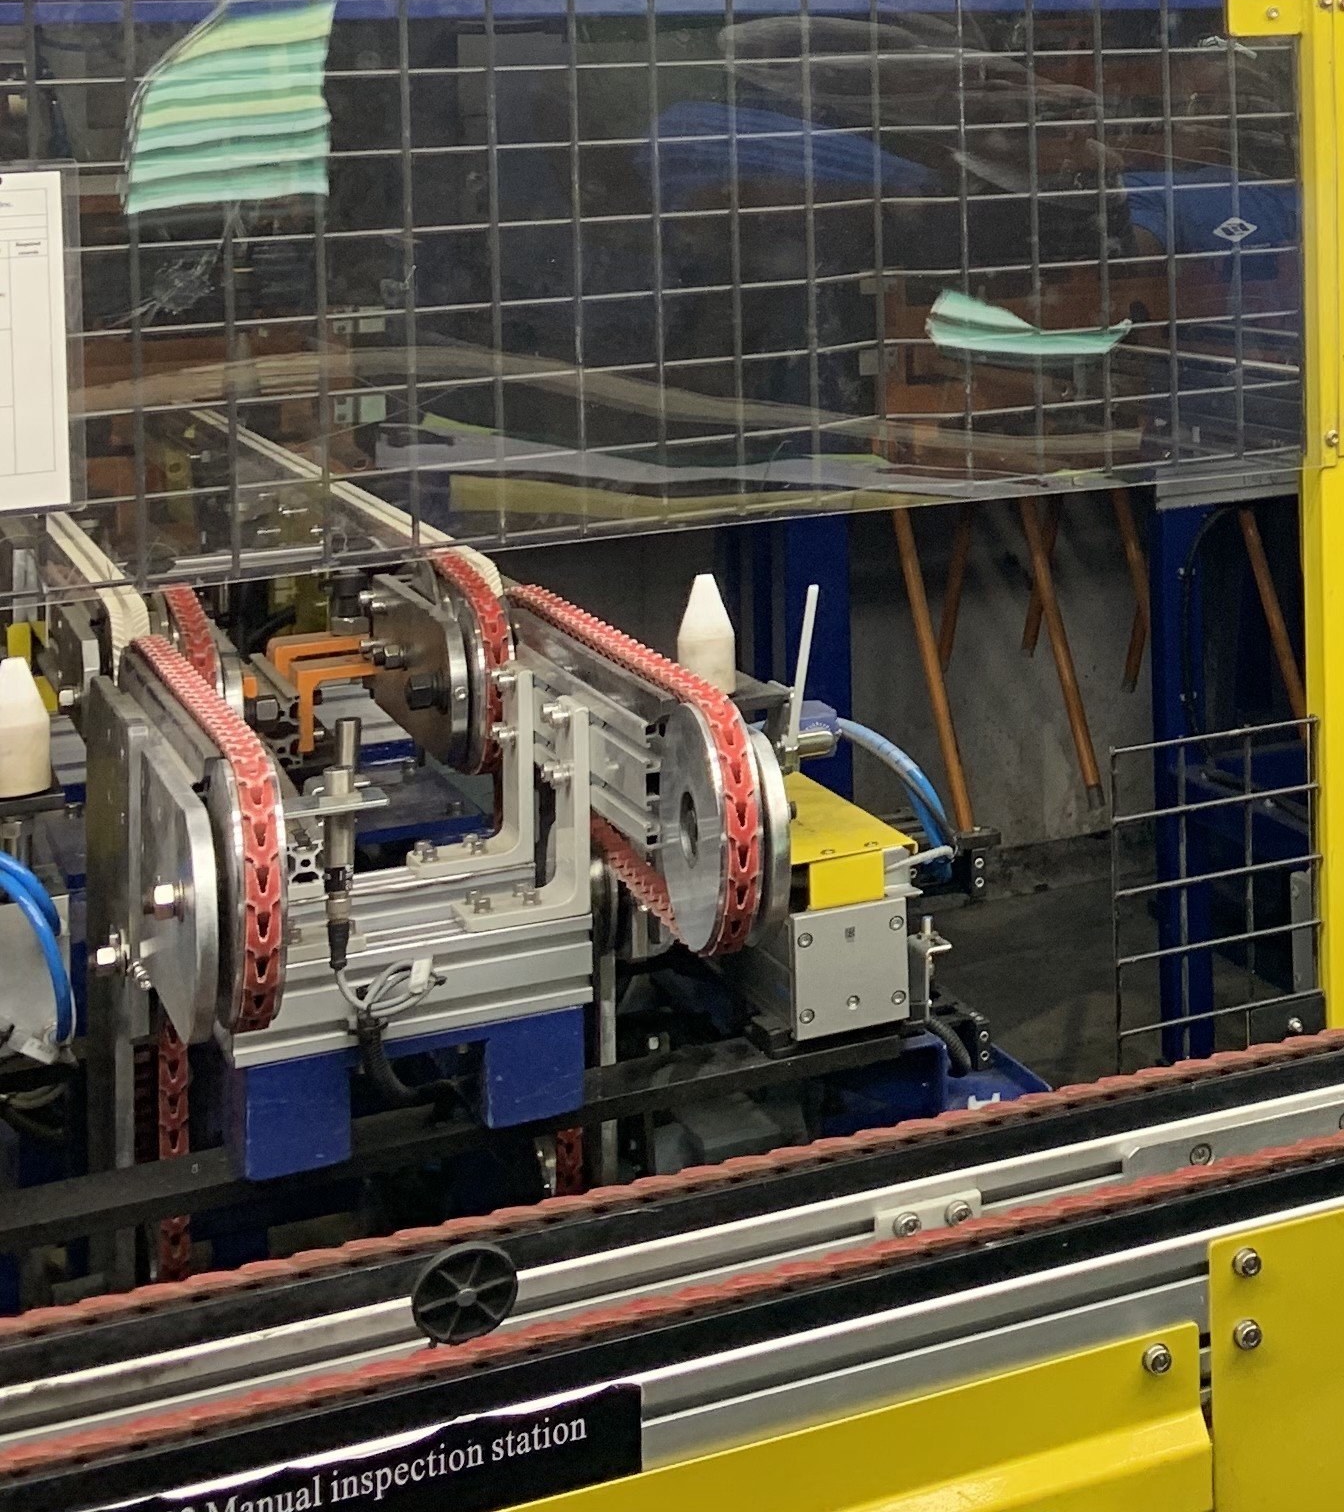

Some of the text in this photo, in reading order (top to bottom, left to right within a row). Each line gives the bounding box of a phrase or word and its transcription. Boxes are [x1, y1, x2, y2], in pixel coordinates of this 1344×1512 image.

[205, 1417, 588, 1512] Manual inspection station
